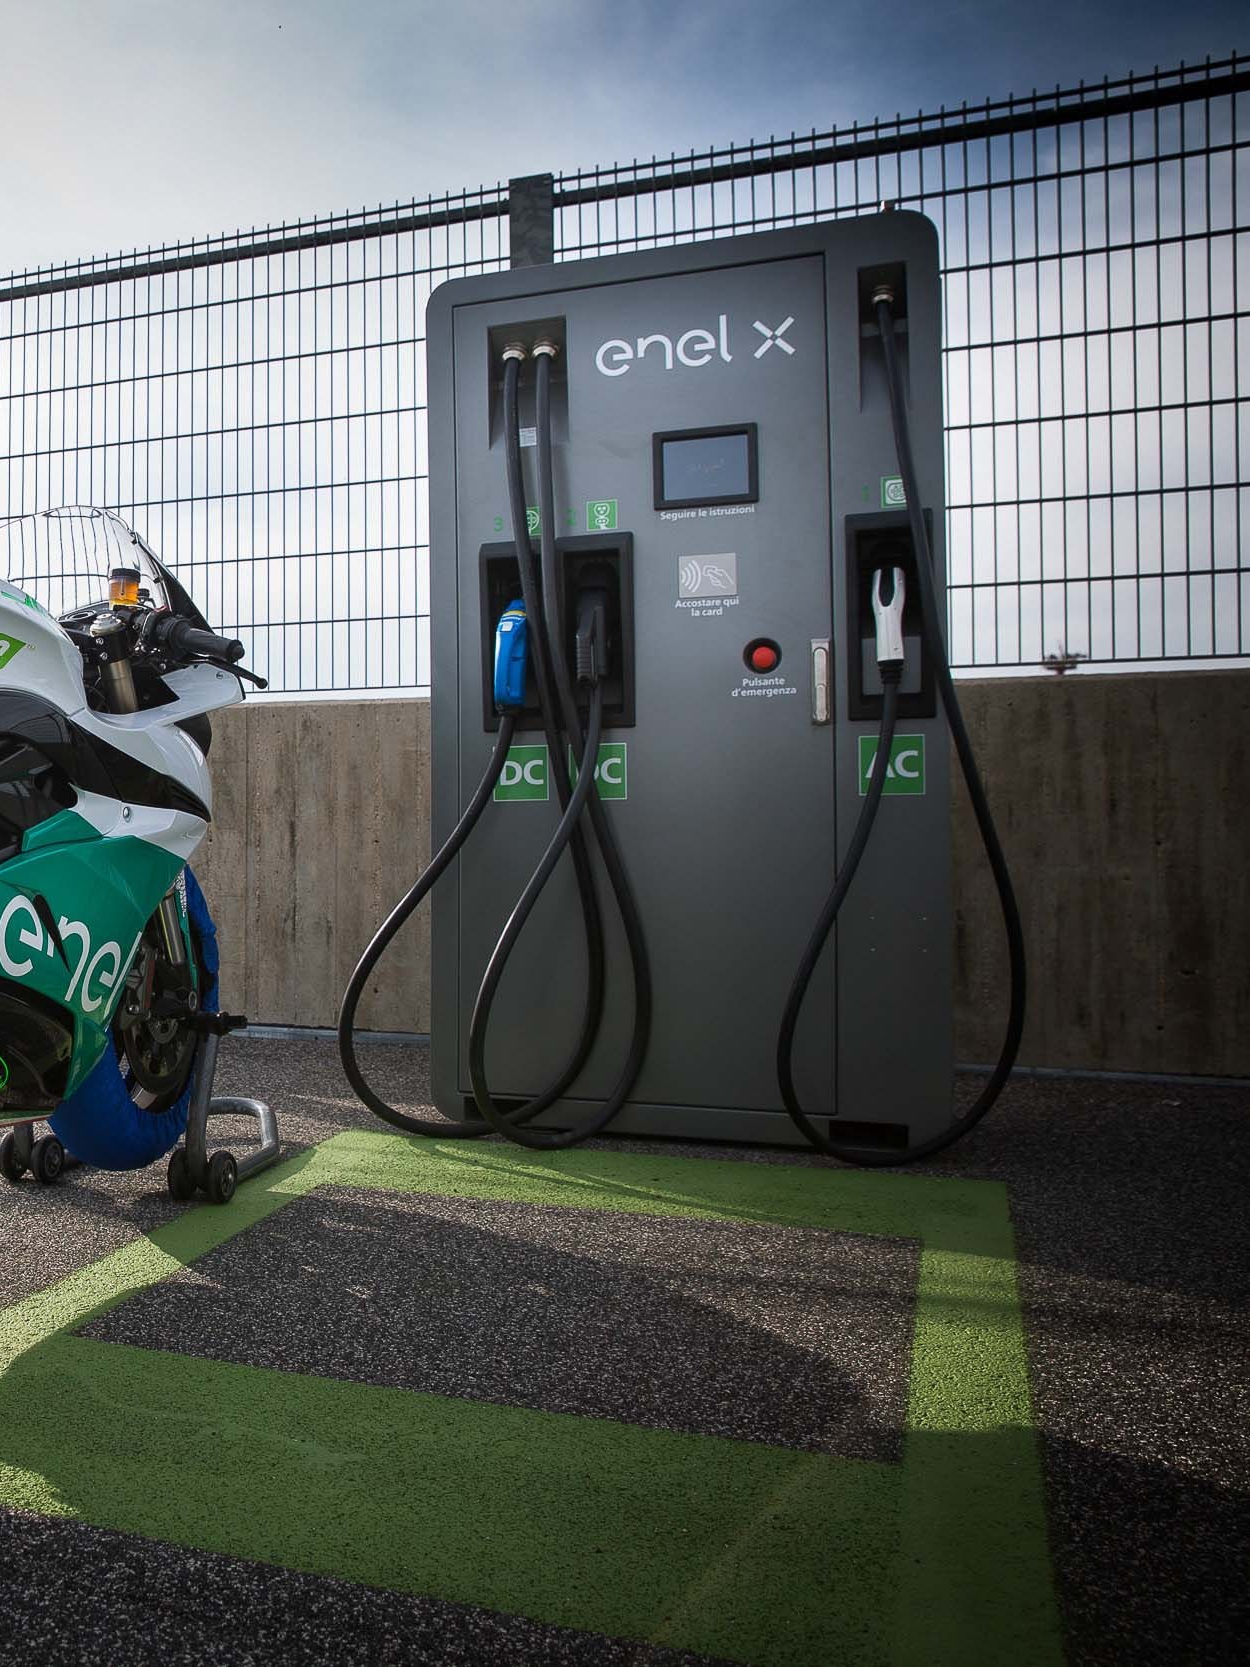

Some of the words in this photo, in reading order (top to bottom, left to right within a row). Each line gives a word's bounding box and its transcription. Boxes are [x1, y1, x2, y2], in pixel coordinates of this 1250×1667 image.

[595, 314, 733, 377] enel
[660, 509, 696, 521] Seguire
[698, 508, 707, 518] le
[709, 503, 755, 517] istruzioni
[675, 599, 722, 609] Accostare
[723, 595, 739, 608] qui
[691, 607, 700, 617] la
[702, 606, 723, 617] card
[742, 676, 786, 687] Pulsante
[731, 687, 798, 698] d'emergenza
[499, 759, 545, 786] DC
